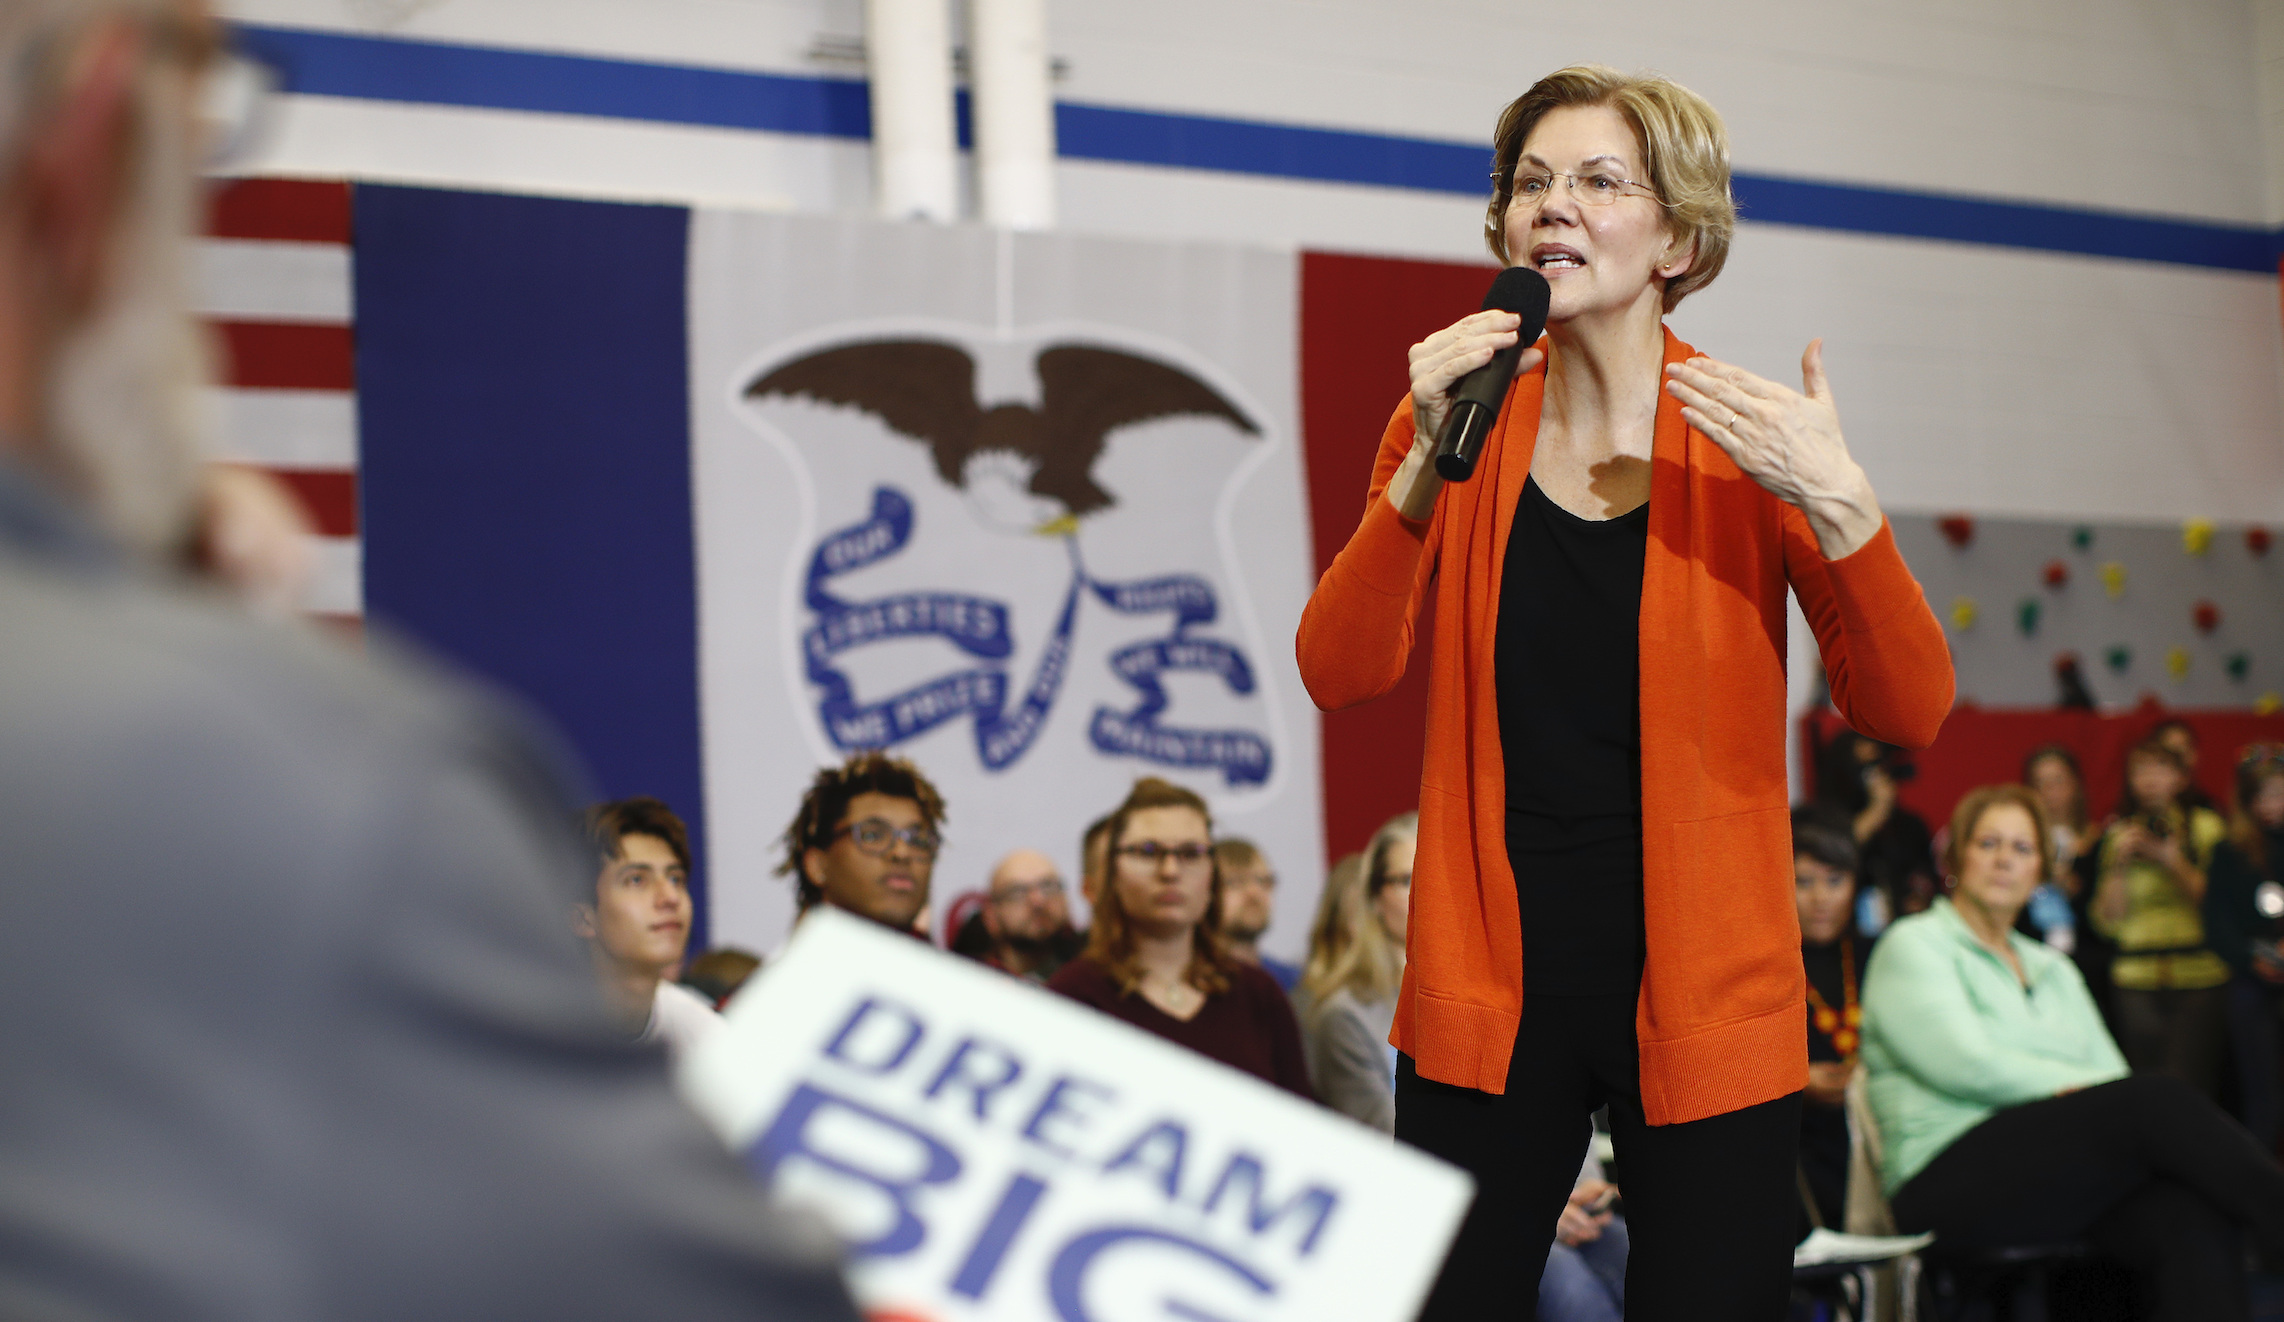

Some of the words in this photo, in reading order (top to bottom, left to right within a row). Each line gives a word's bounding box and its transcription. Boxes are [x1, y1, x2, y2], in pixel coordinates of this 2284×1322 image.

[809, 600, 999, 660] LIBERTIES
[831, 709, 890, 744] WE
[893, 676, 993, 727] PRIZE
[745, 1080, 1278, 1322] BIG
[821, 994, 1341, 1258] DREAM
